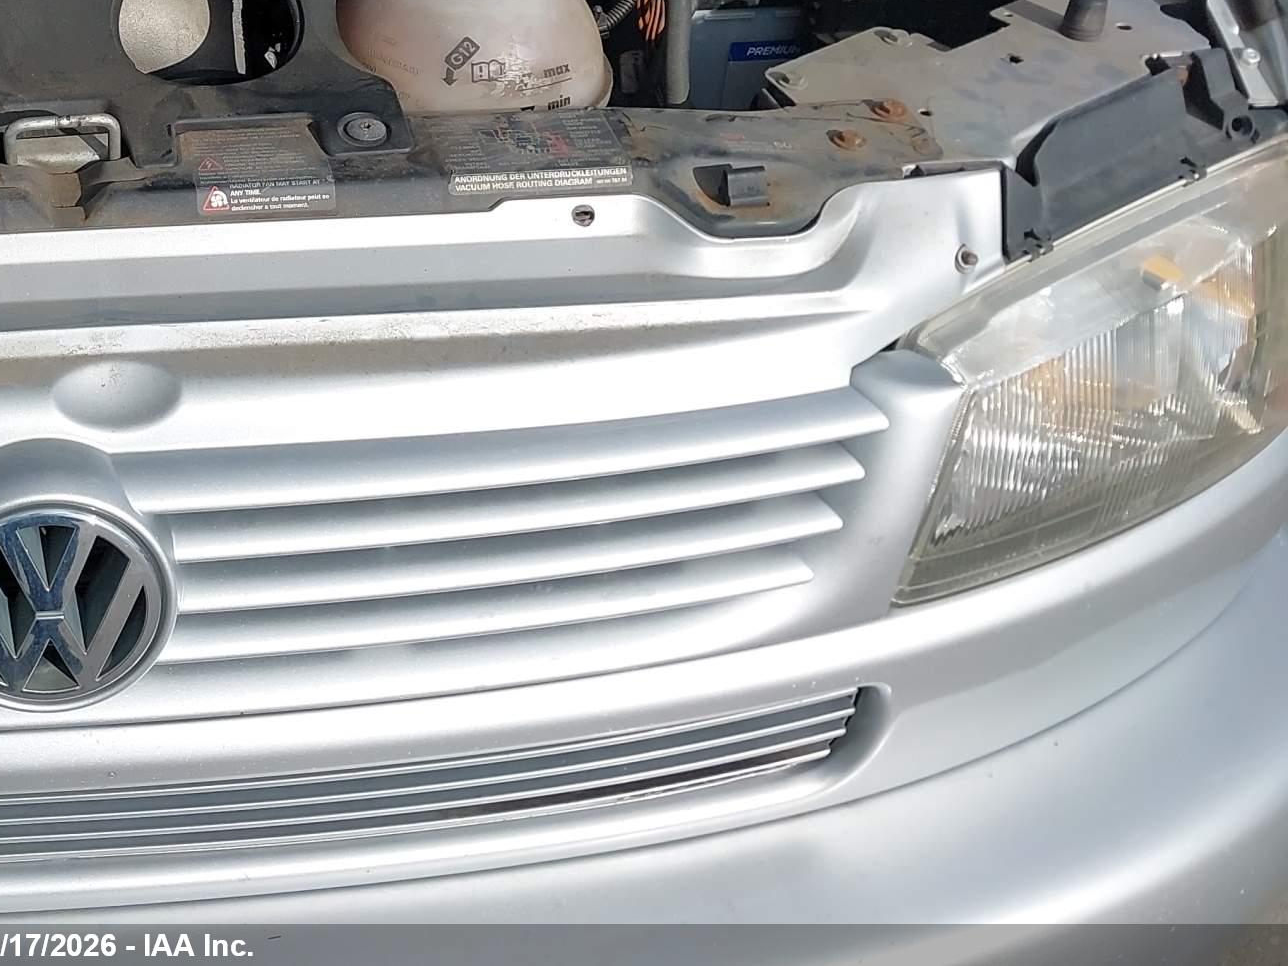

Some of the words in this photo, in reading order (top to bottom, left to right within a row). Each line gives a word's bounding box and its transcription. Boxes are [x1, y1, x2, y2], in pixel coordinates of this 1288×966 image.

[449, 40, 477, 66] G12
[544, 63, 570, 78] max
[548, 94, 570, 111] min
[454, 173, 508, 183] ANORDNUNG
[509, 171, 526, 180] DER
[527, 167, 627, 180] UNTERDRUCKLEITUNGEN
[455, 183, 491, 192] VACUUM
[492, 181, 515, 190] HOSE
[516, 179, 553, 188] ROUTING
[554, 177, 593, 187] DIAGRAM
